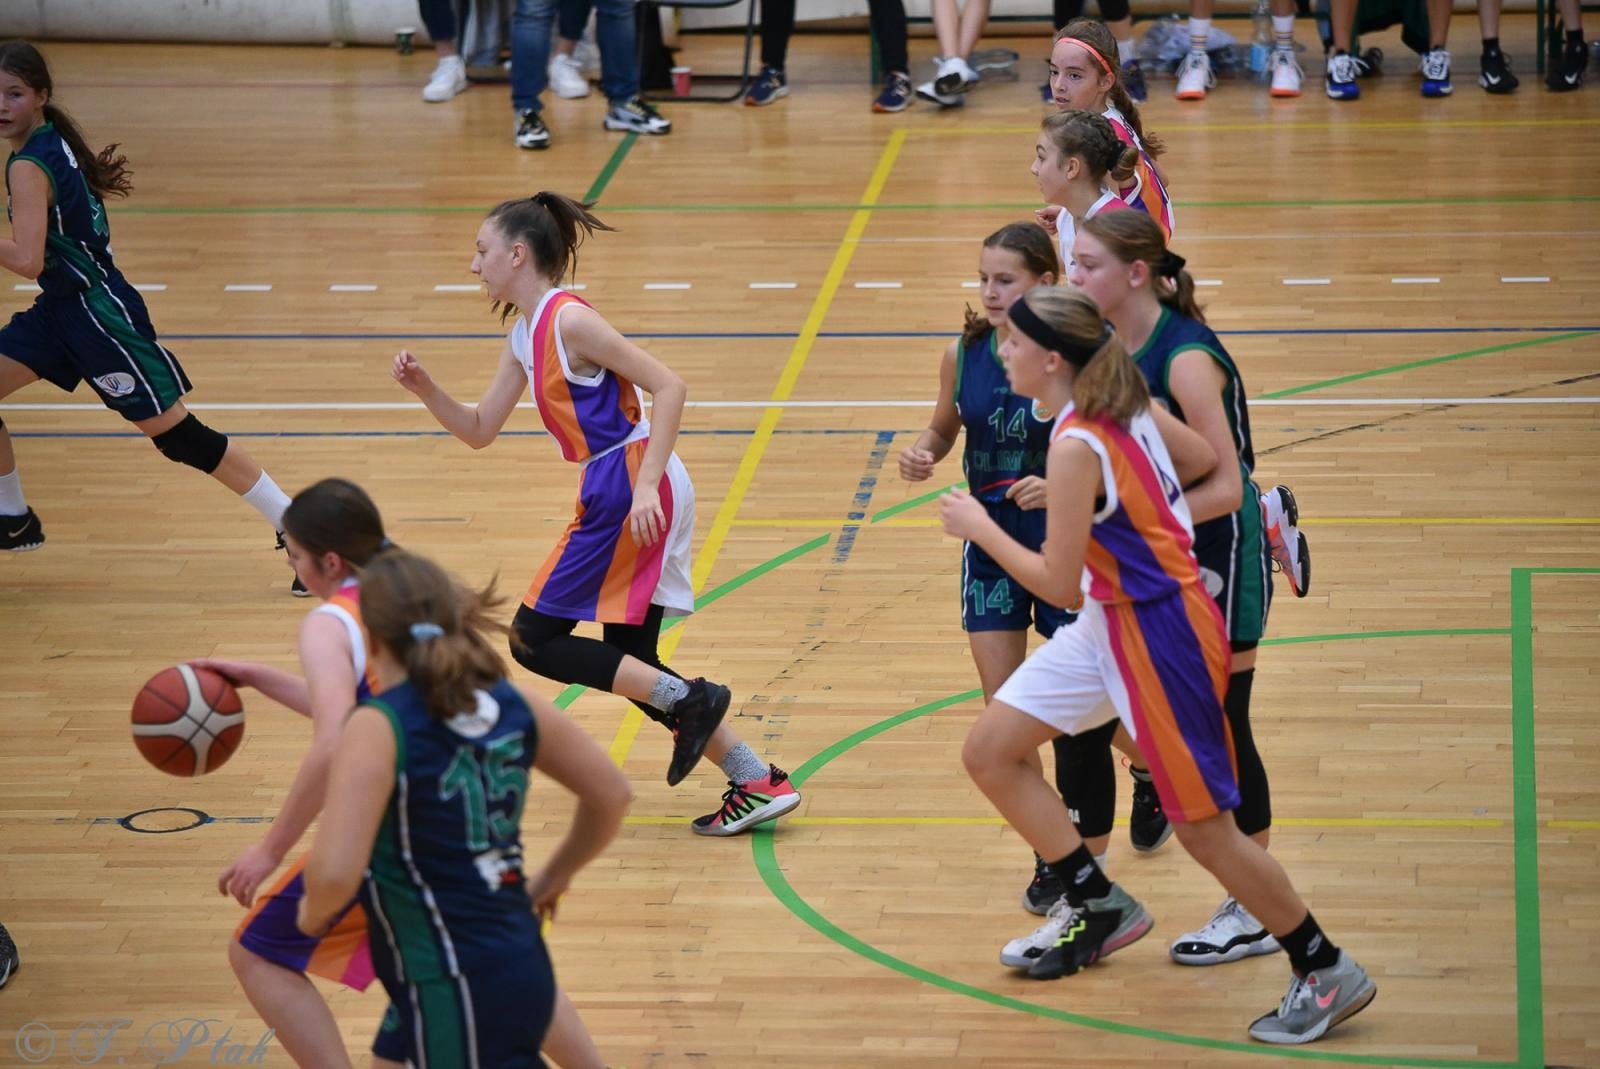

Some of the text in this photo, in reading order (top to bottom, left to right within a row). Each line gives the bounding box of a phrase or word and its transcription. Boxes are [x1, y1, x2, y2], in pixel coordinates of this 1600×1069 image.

[987, 407, 1027, 443] 14
[968, 578, 1014, 616] 14
[439, 730, 530, 851] 15
